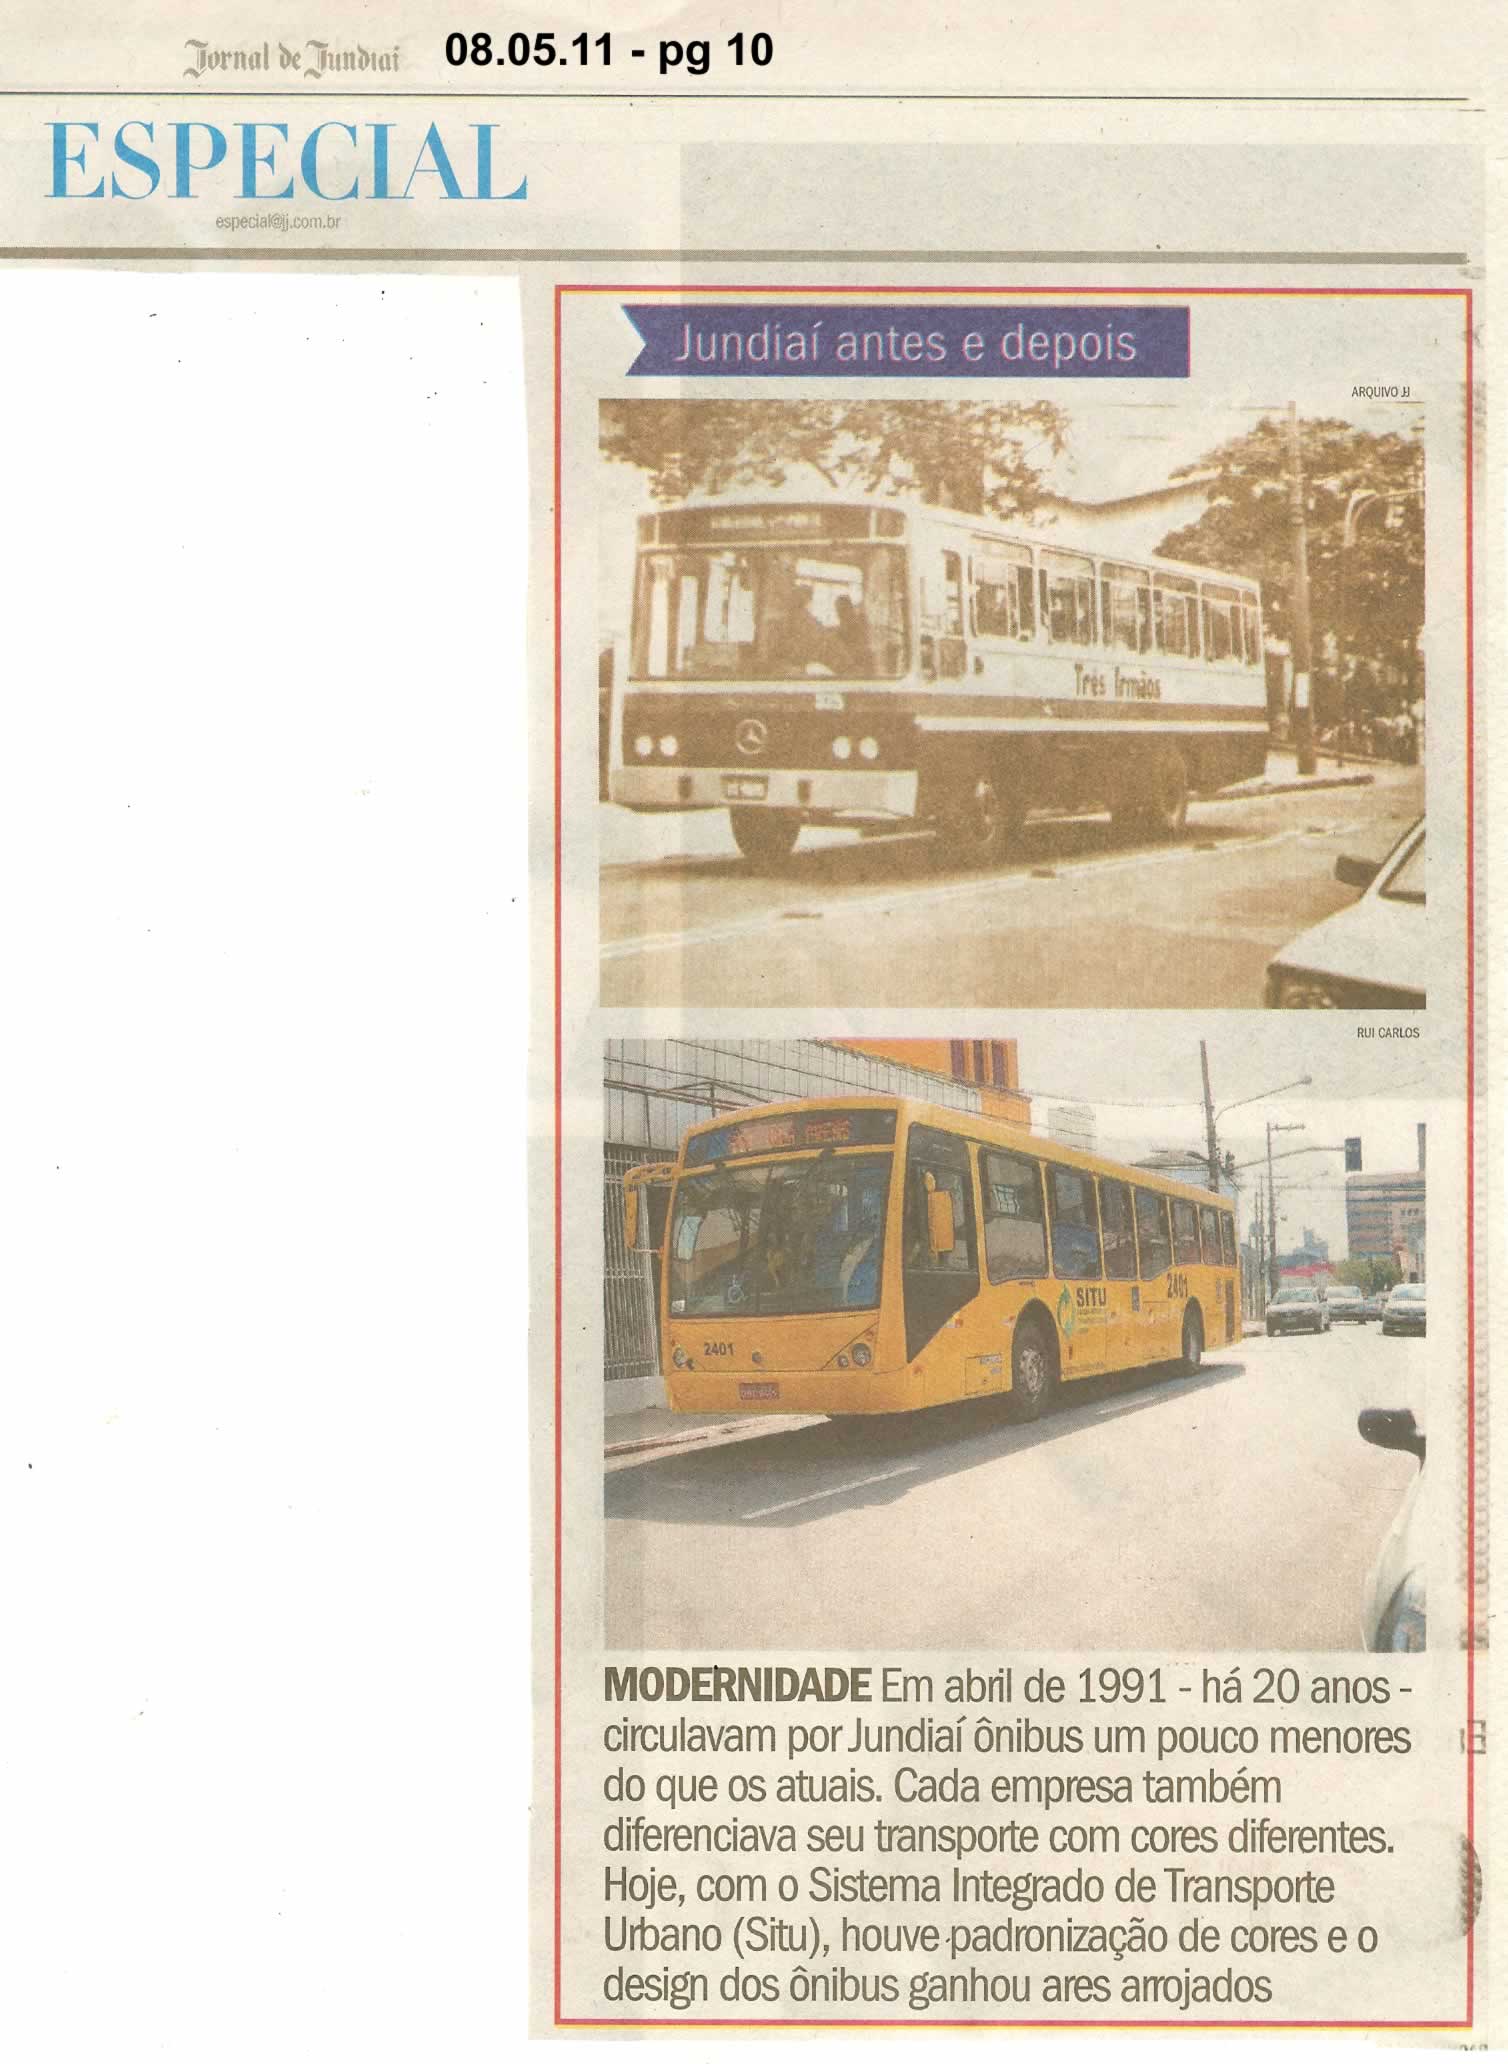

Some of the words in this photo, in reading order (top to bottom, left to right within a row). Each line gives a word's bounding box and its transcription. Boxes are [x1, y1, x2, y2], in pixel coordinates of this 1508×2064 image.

[183, 39, 269, 79] Jornal
[278, 41, 301, 71] de
[44, 120, 529, 201] ESPECIAL
[215, 213, 341, 232] especial@jj.com.br
[675, 321, 822, 362] Jundiaí
[837, 332, 947, 362] antes
[962, 332, 985, 361] e
[1001, 323, 1138, 370] depois
[1351, 386, 1399, 400] ARQUIVO
[1074, 663, 1106, 698] Três
[1115, 665, 1161, 700] Irmãos
[1356, 1027, 1375, 1039] RUI
[1378, 1026, 1420, 1039] CARLOS
[1076, 1287, 1107, 1308] SITU
[1167, 1272, 1189, 1299] 2401
[703, 1342, 735, 1356] 2401
[604, 1664, 873, 1702] MODERNIDADE
[882, 1667, 933, 1703] Em
[944, 1667, 1012, 1703] abril
[1023, 1667, 1066, 1704] de
[1079, 1667, 1166, 1704] 1991
[1202, 1666, 1242, 1704] há
[1253, 1667, 1300, 1704] 20
[1310, 1676, 1391, 1704] anos
[603, 1716, 776, 1753] circulavam
[788, 1725, 843, 1760] por
[847, 1715, 967, 1753] Jundiaí
[974, 1716, 1084, 1753] ônibus
[1094, 1726, 1145, 1753] um
[1158, 1726, 1259, 1761] pouco
[1270, 1726, 1412, 1754] menores
[603, 1766, 646, 1802] do
[656, 1774, 718, 1810] que
[728, 1775, 767, 1802] os
[776, 1767, 882, 1803] atuais.
[894, 1766, 980, 1803] Cada
[991, 1775, 1133, 1811] empresa
[1142, 1766, 1281, 1804] também
[603, 1815, 797, 1852] diferenciava
[806, 1825, 864, 1852] seu
[873, 1819, 1039, 1860] transporte
[1049, 1825, 1120, 1853] com
[1131, 1826, 1219, 1854] cores
[1228, 1817, 1394, 1854] diferentes.
[604, 1866, 685, 1910] Hoje,
[696, 1874, 767, 1902] com
[778, 1875, 799, 1902] o
[808, 1866, 941, 1903] Sistema
[953, 1867, 1105, 1912] Integrado
[1115, 1867, 1157, 1903] de
[1163, 1867, 1335, 1911] Transporte
[604, 1916, 722, 1952] Urbano
[733, 1916, 830, 1960] (Situ),
[842, 1916, 940, 1952] houve
[951, 1916, 1168, 1962] padronização
[1178, 1917, 1220, 1953] de
[1230, 1925, 1318, 1953] cores
[1327, 1926, 1348, 1953] e
[1357, 1926, 1378, 1953] o
[603, 1966, 708, 2010] design
[720, 1966, 780, 2002] dos
[789, 1965, 900, 2002] ônibus
[908, 1967, 1030, 2011] ganhou
[1042, 1975, 1112, 2003] ares
[1120, 1967, 1273, 2011] arrojados
